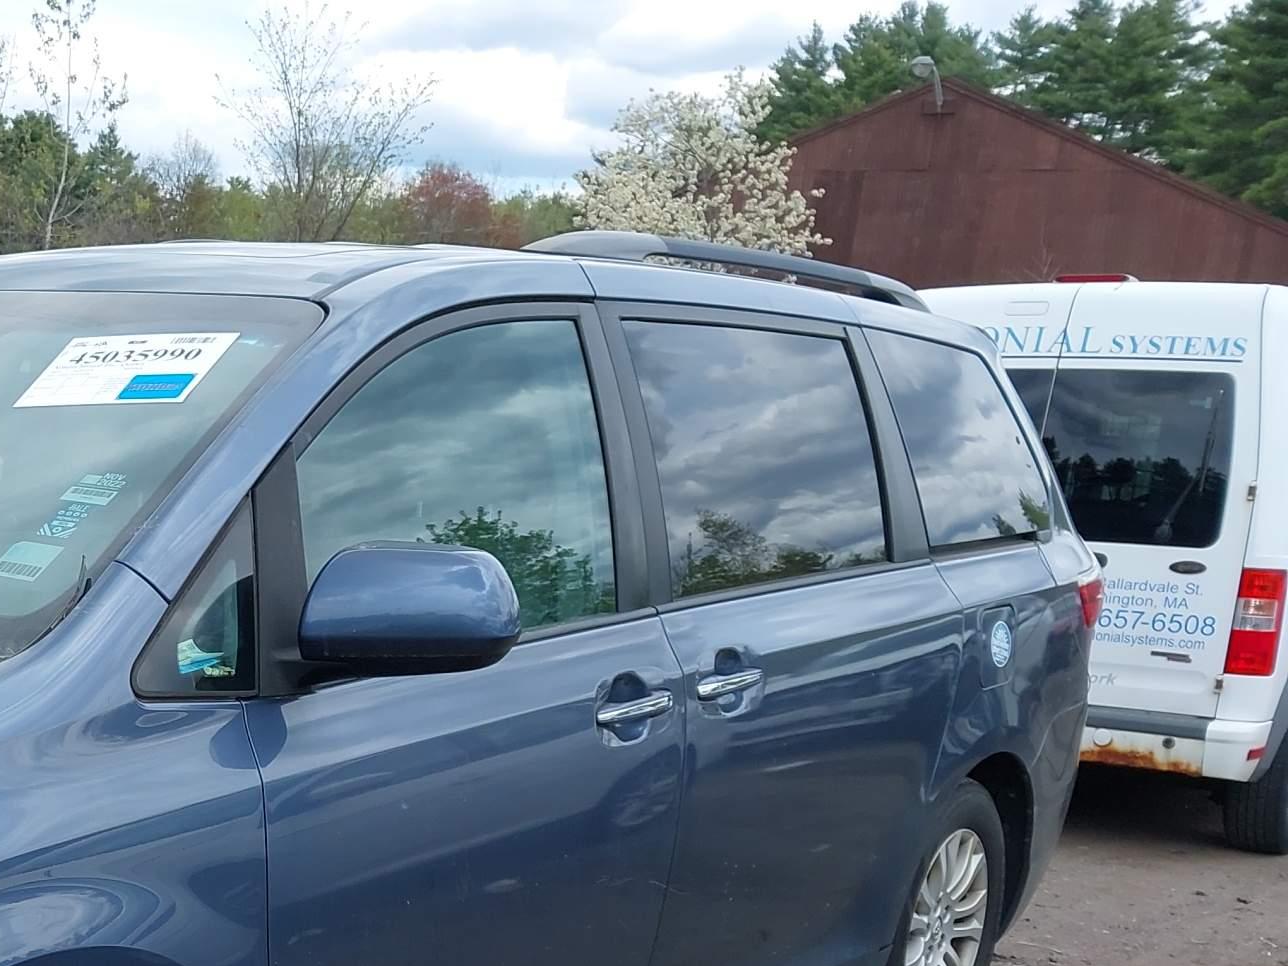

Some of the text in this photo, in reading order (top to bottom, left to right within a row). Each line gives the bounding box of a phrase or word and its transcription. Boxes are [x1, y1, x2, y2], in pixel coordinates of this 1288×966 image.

[1110, 334, 1247, 357] SYSTEMS
[69, 348, 202, 365] 45035990
[1184, 582, 1203, 597] St.
[1164, 596, 1189, 610] MA
[1098, 608, 1216, 637] 657-6508
